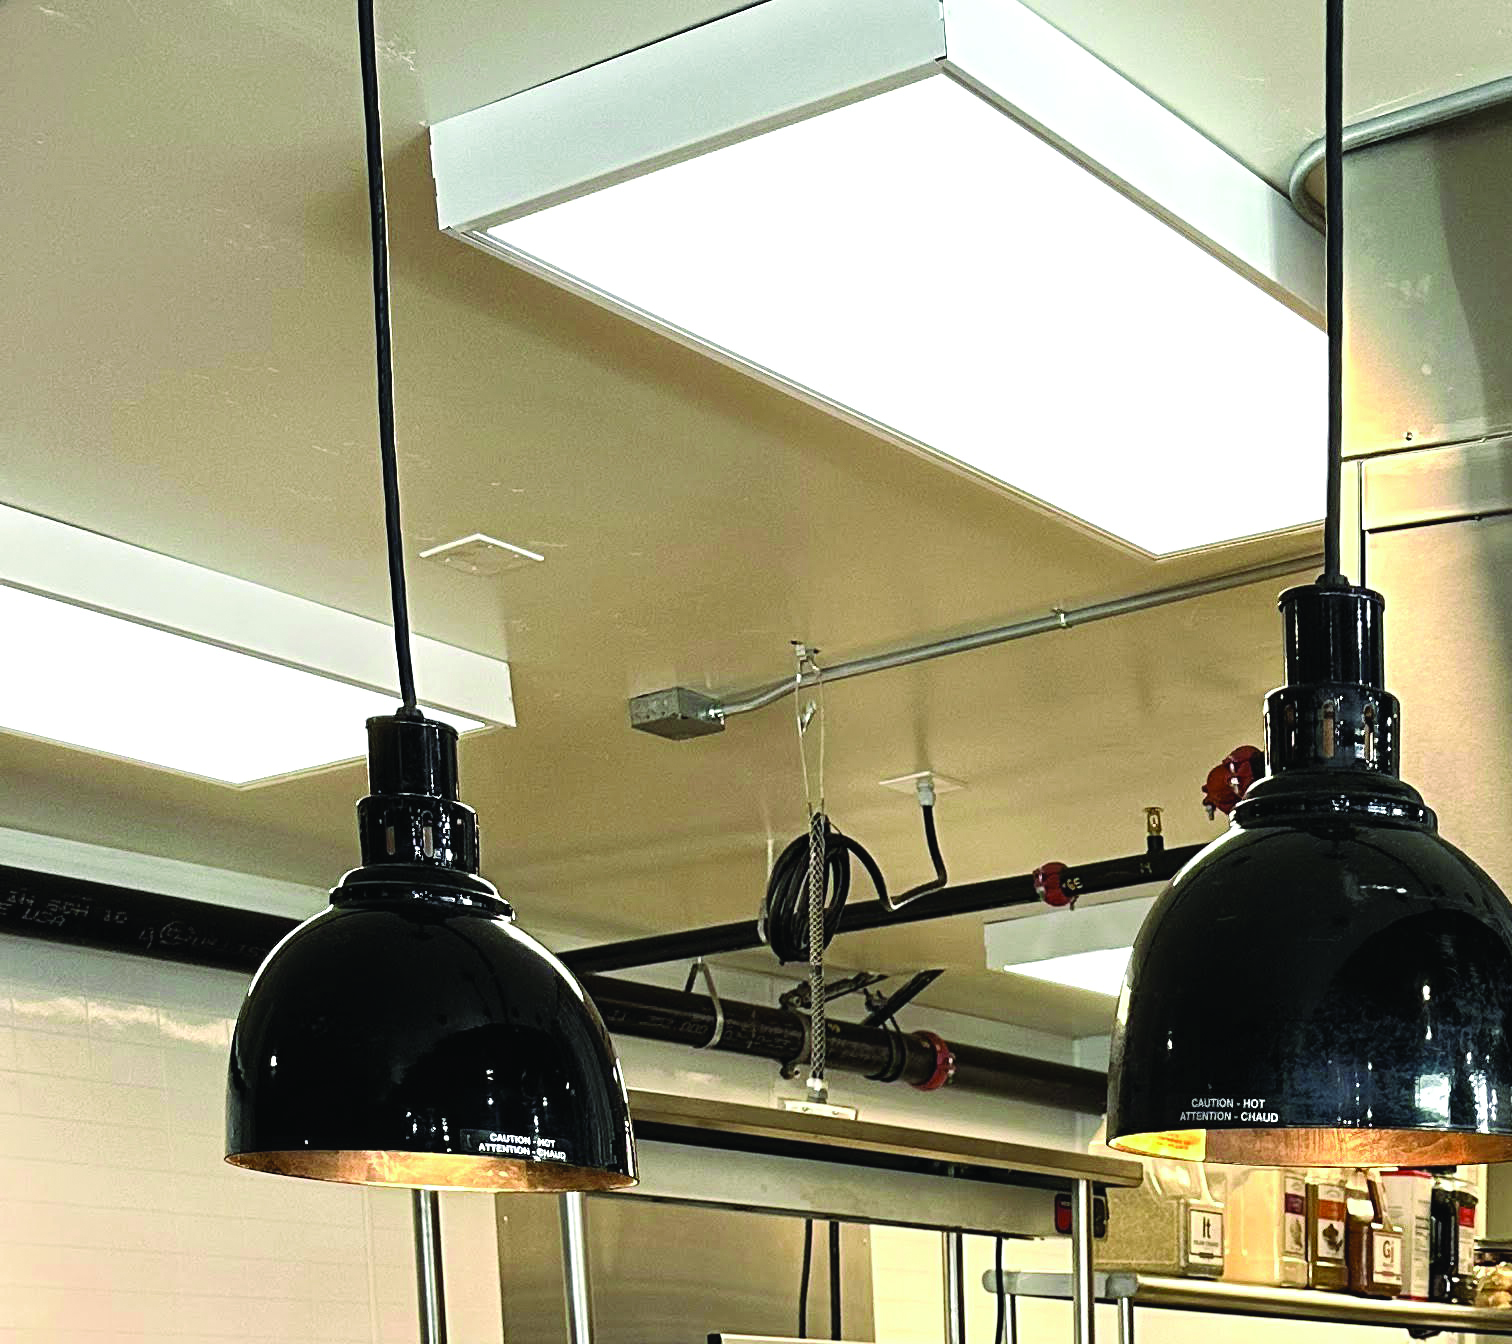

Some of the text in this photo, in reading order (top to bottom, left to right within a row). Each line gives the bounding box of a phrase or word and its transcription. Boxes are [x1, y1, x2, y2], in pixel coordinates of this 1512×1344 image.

[1191, 1097, 1234, 1109] CAUTION
[1242, 1098, 1266, 1109] HOT
[1180, 1111, 1232, 1121] ATTENTION
[1240, 1112, 1279, 1123] CHAUD
[489, 1132, 532, 1145] CAUTION
[536, 1138, 556, 1148] HOT
[478, 1143, 530, 1155] ATTENTION
[536, 1148, 567, 1162] CHAUD
